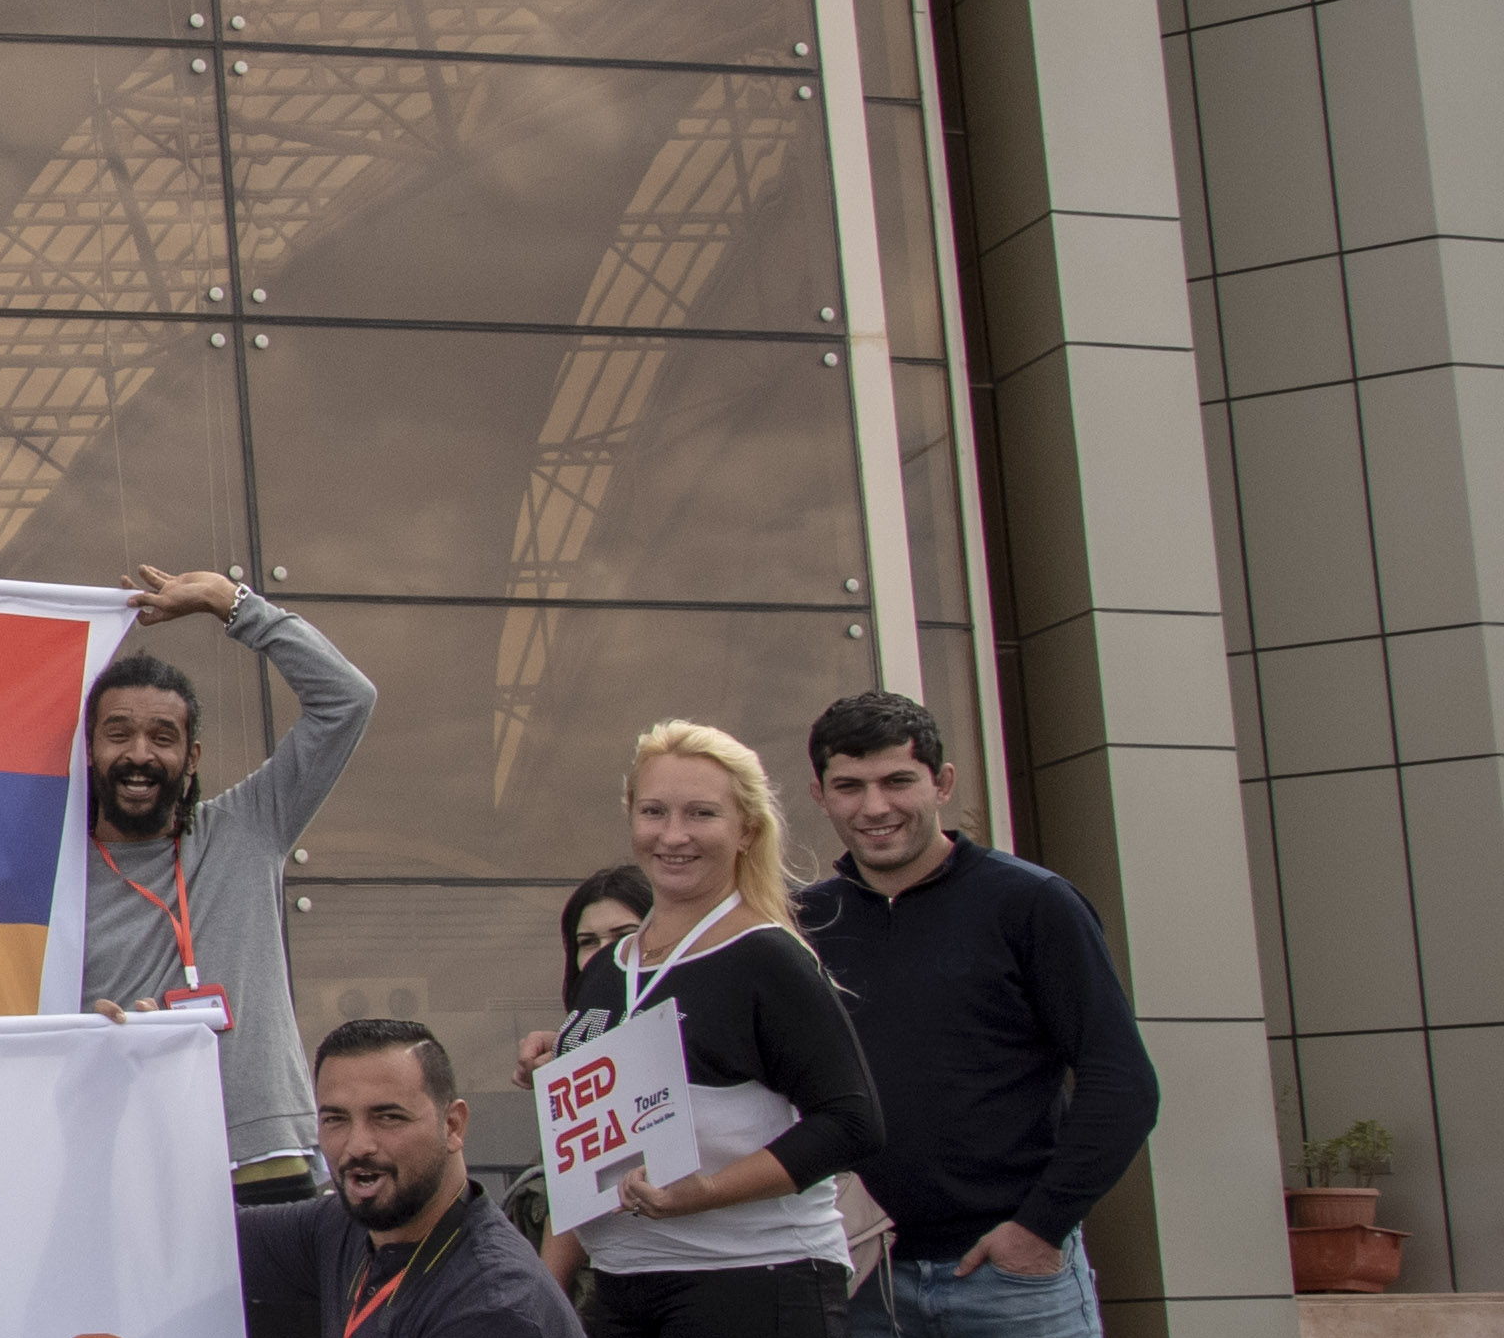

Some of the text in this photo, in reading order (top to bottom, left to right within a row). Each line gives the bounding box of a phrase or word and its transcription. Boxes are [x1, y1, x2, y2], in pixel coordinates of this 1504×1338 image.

[548, 1057, 616, 1121] RED
[634, 1087, 670, 1113] Tours
[556, 1109, 627, 1174] SEA
